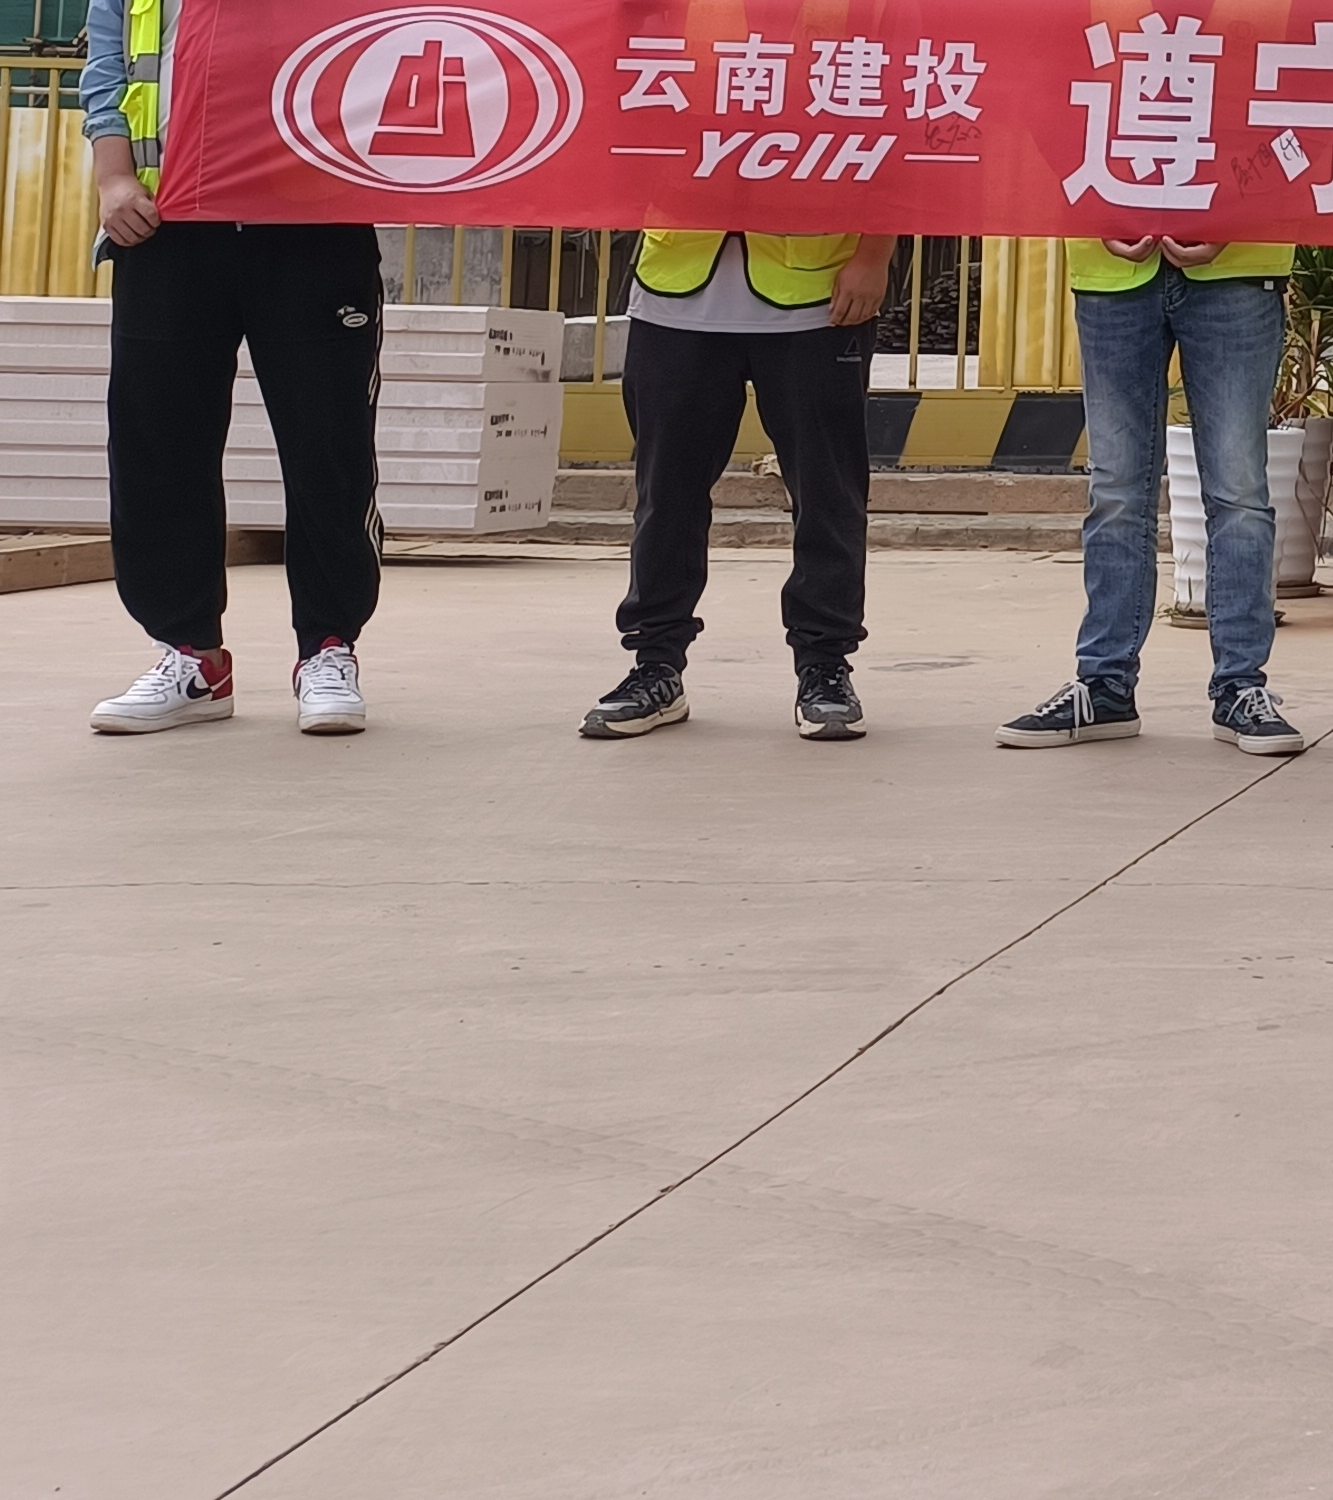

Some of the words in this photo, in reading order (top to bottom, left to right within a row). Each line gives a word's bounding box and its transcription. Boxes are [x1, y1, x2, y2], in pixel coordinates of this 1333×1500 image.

[615, 32, 988, 122] 云南建投
[692, 130, 898, 181] YCIH
